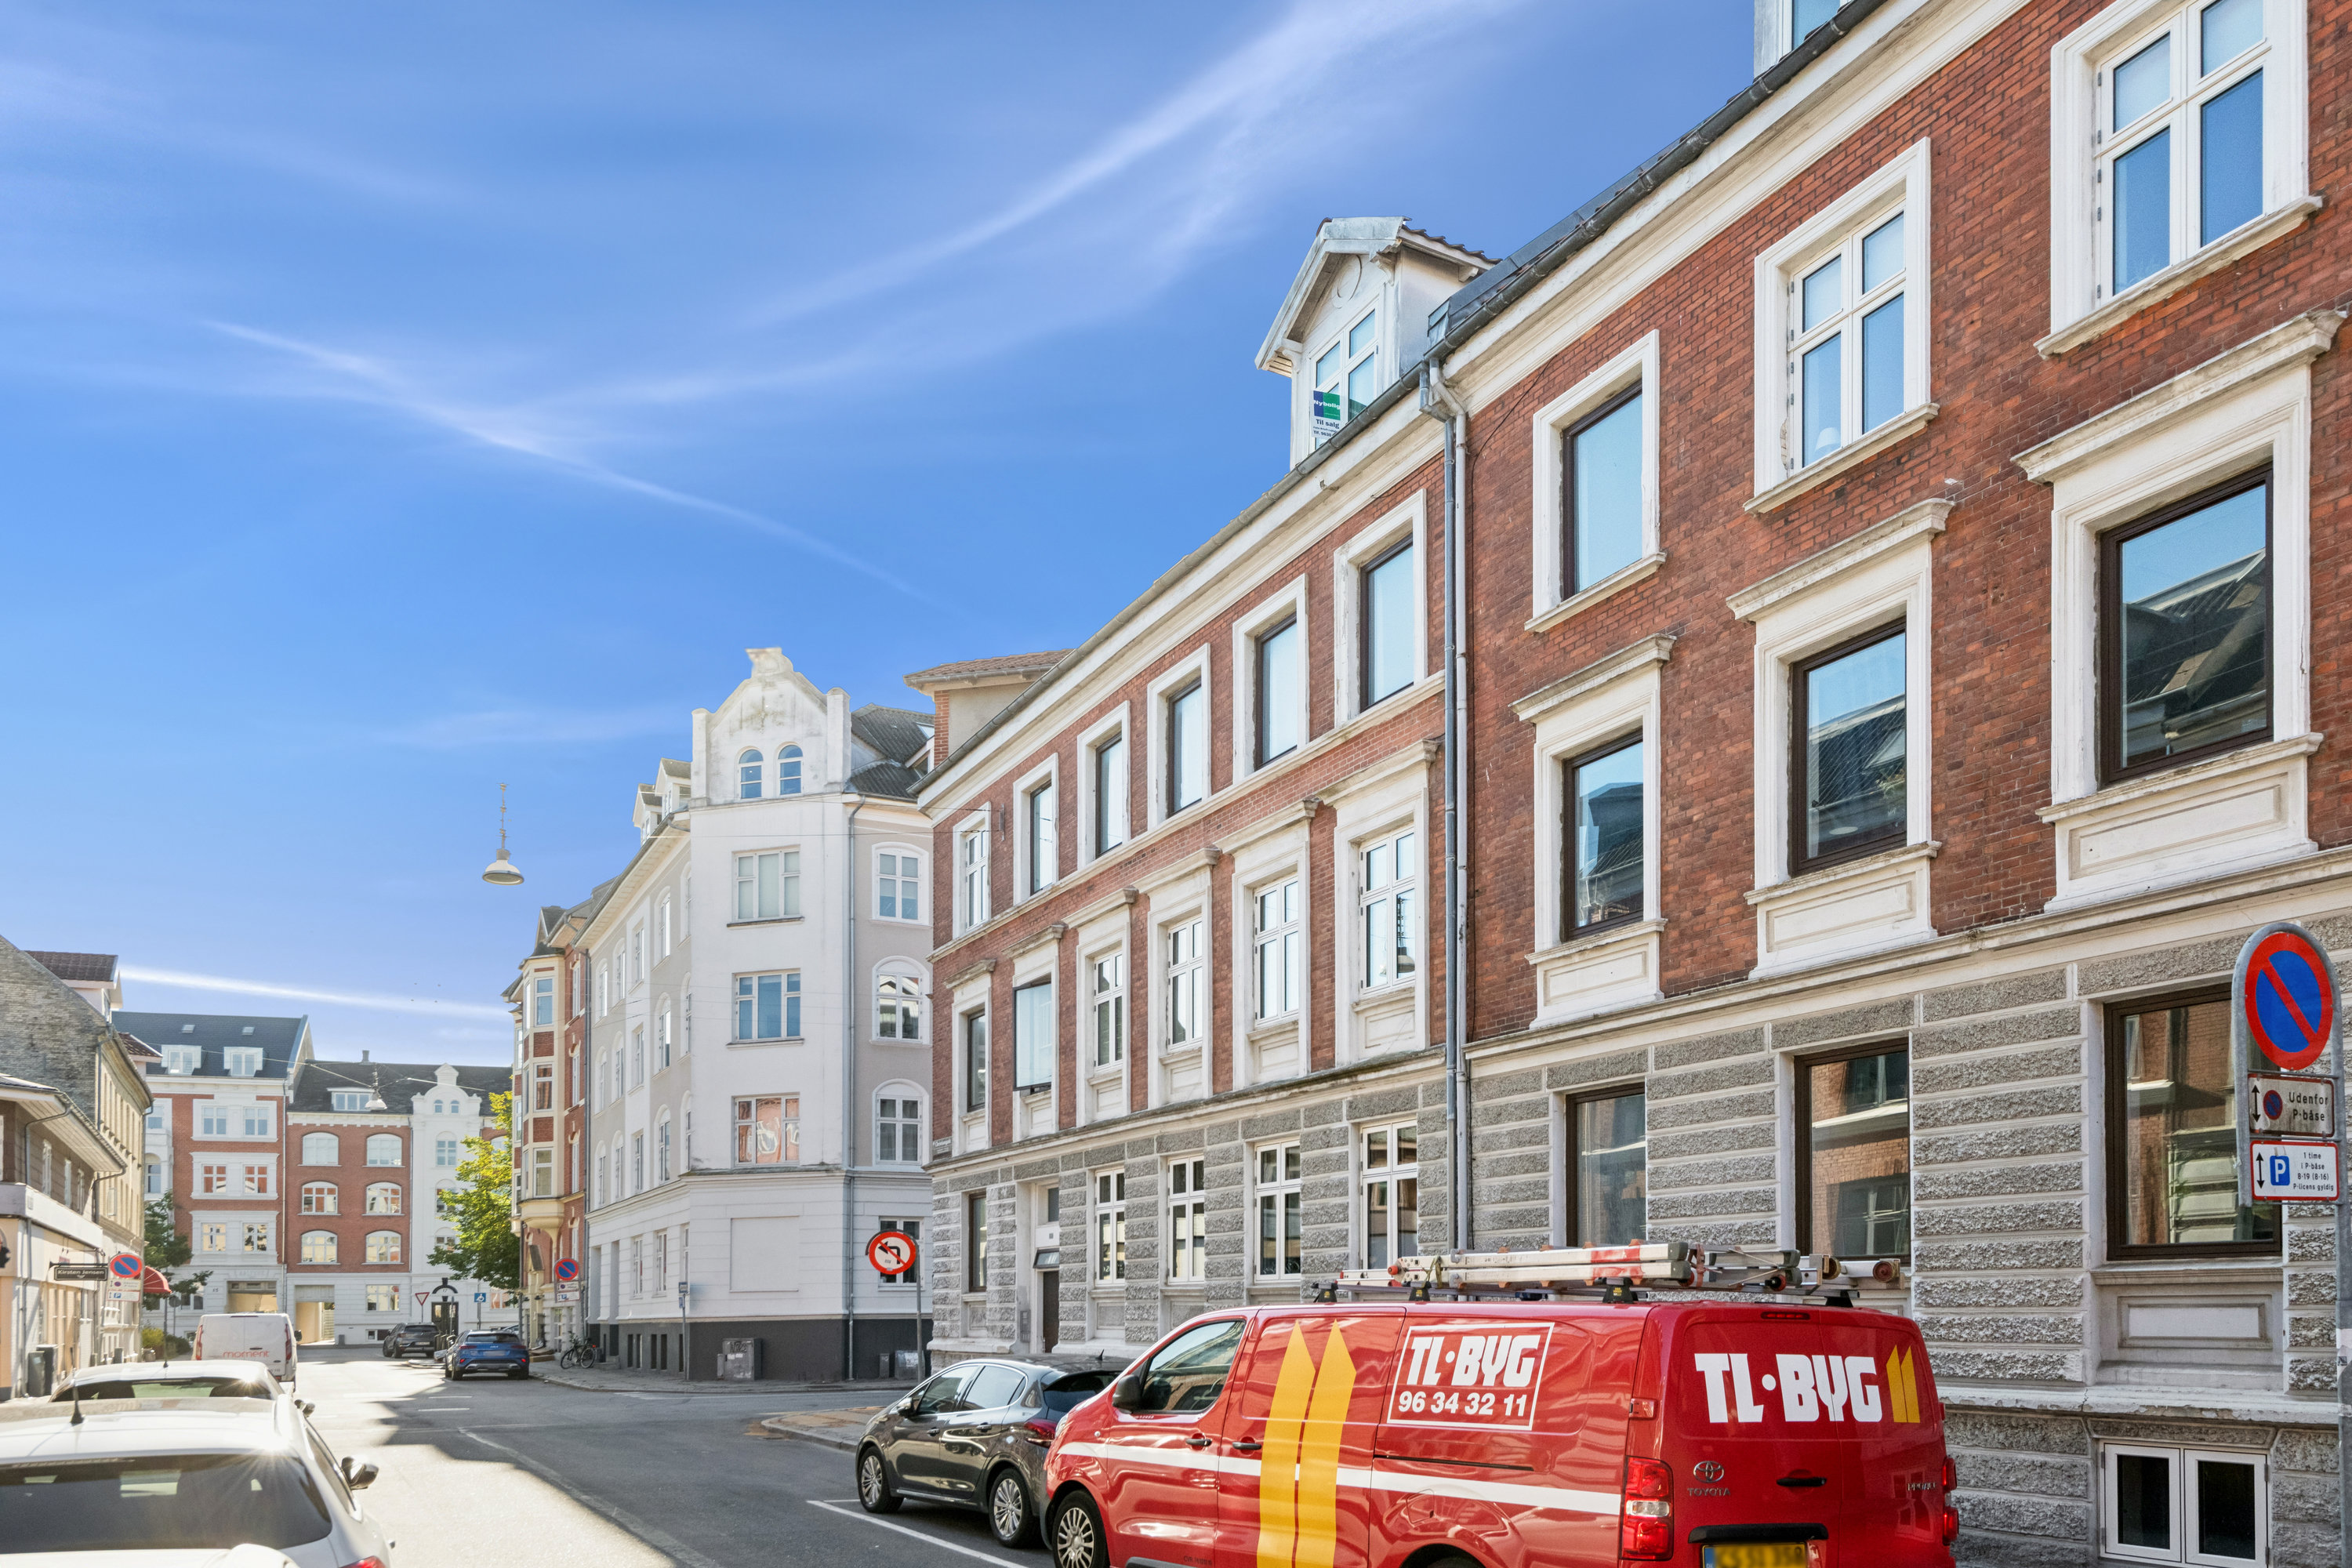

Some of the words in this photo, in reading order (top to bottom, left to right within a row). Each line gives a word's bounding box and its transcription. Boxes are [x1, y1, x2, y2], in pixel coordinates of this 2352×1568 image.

[1313, 400, 1341, 410] Nybolig
[1325, 421, 1340, 430] salg
[2288, 1092, 2328, 1105] Udenfor
[2317, 1183, 2334, 1192] gyldig
[222, 1350, 270, 1359] moment
[1398, 1391, 1427, 1413] 96
[1430, 1391, 1460, 1414] 34
[1465, 1392, 1496, 1415] 32
[1503, 1393, 1527, 1417] 11
[1687, 1487, 1732, 1497] TOYOTA
